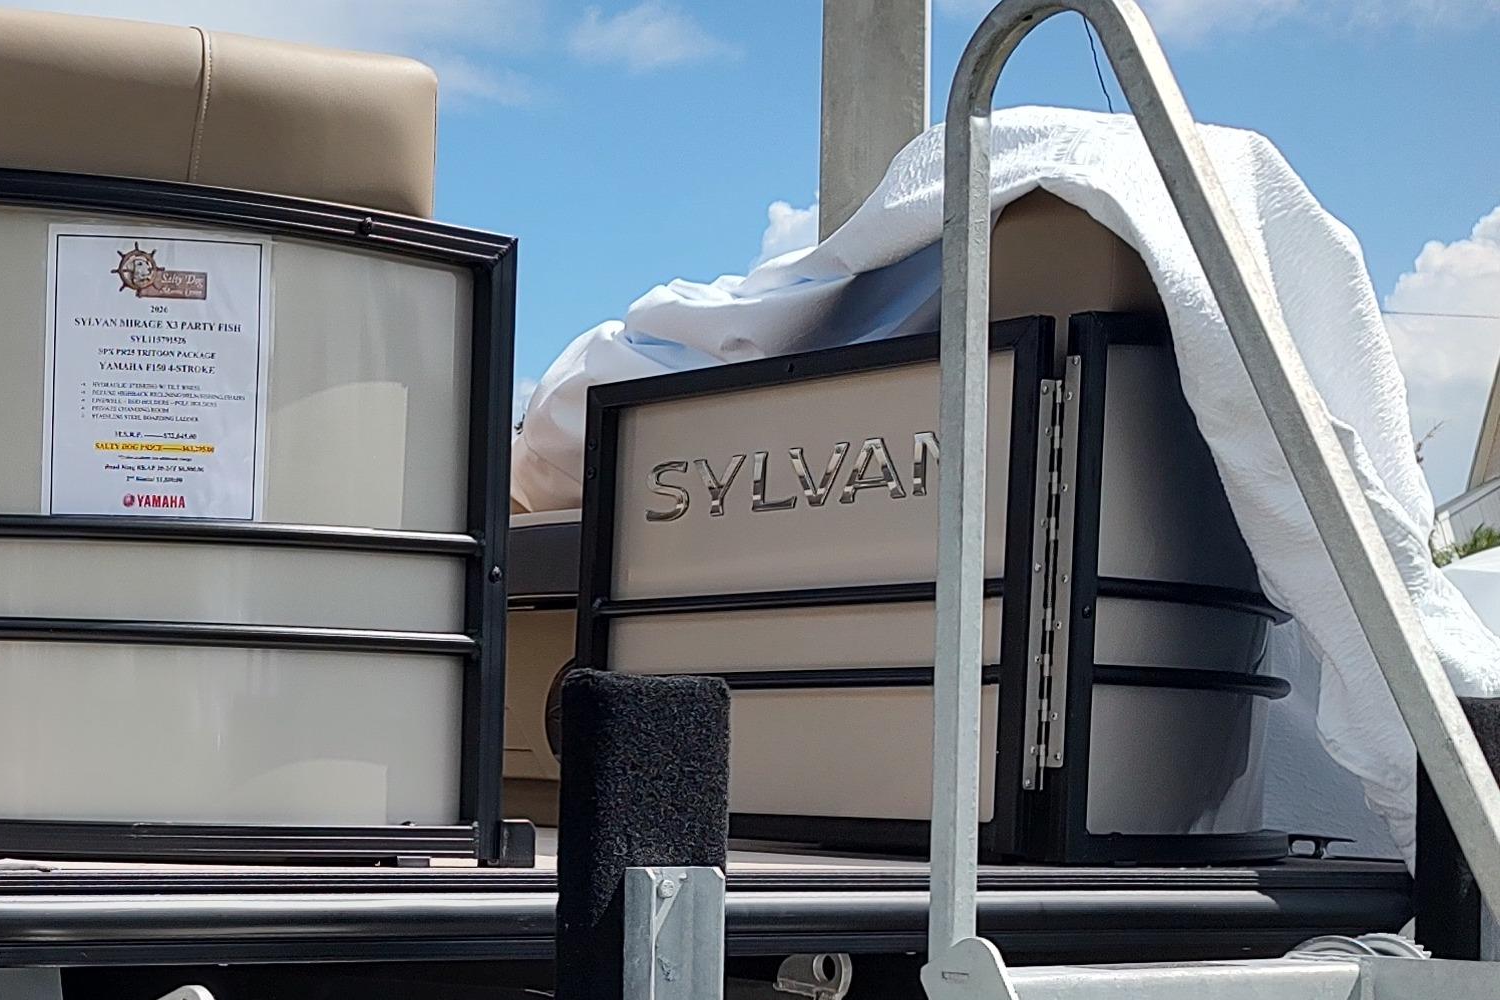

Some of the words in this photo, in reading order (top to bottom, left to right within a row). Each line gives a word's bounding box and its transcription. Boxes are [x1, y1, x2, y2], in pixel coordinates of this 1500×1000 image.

[161, 273, 182, 285] Salty
[185, 274, 204, 288] Dog
[74, 317, 117, 328] SYLVAN
[120, 318, 162, 329] MIRAGE
[166, 320, 178, 329] X3
[181, 321, 215, 332] PARTY
[218, 323, 241, 333] FISH
[138, 349, 175, 358] TRITOON
[177, 351, 216, 360] PACKAGE
[99, 361, 143, 371] YAMAHA
[146, 363, 166, 372] F150
[167, 364, 215, 375] 4-STROKE
[95, 442, 119, 450] SALTY
[137, 494, 186, 508] YAMAHA
